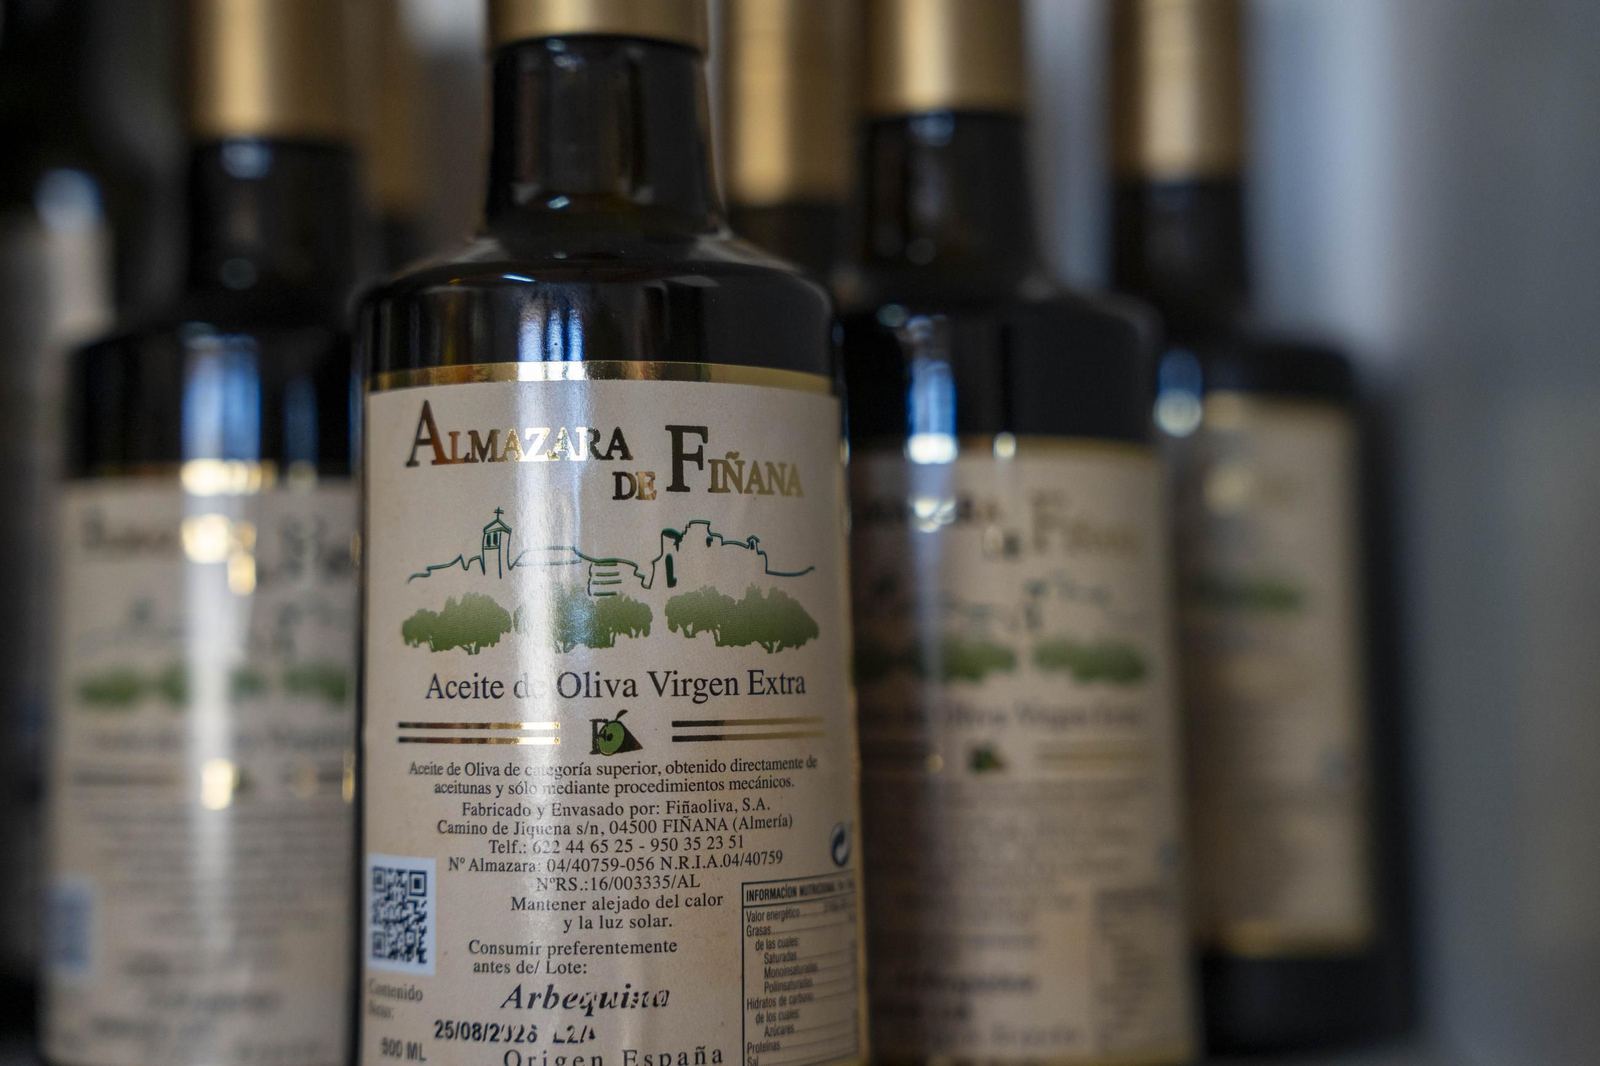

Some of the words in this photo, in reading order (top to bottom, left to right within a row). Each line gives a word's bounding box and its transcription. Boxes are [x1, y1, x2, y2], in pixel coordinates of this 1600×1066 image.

[406, 400, 633, 467] ALMAZARA
[612, 471, 657, 501] DE
[665, 425, 804, 498] FIÑANA
[426, 672, 505, 700] Aceite
[556, 671, 639, 699] Oliva
[647, 670, 739, 704] Virgen
[747, 669, 806, 697] Extra
[409, 760, 444, 776] Aceite
[447, 762, 461, 776] de
[464, 761, 501, 777] Oliva
[504, 761, 521, 776] de
[596, 760, 662, 780] superior,
[665, 758, 727, 776] obtenido
[730, 756, 804, 774] directamente
[806, 754, 818, 769] de
[434, 781, 491, 796] aceitunas
[495, 784, 504, 799] y
[508, 780, 538, 796] sólo
[543, 779, 610, 796] mediante
[614, 778, 725, 798] procedimientos
[729, 775, 795, 793] mecánicos.
[462, 802, 532, 817] Fabricado
[537, 805, 545, 820] y
[551, 802, 624, 817] Envasado
[630, 804, 661, 820] por:
[665, 799, 738, 815] Fiñaoliva,
[742, 797, 770, 812] S.A.
[437, 819, 488, 836] Camino
[492, 820, 509, 836] de
[576, 820, 605, 837] s/n,
[609, 818, 657, 835] 04500
[662, 815, 729, 834] FIÑANA
[732, 813, 793, 834] (Almería)
[489, 839, 527, 854] Telf.:
[532, 840, 561, 854] 622
[566, 839, 585, 854] 44
[590, 839, 609, 853] 65
[615, 838, 633, 853] 25
[650, 837, 678, 852] 950
[683, 837, 701, 851] 35
[706, 835, 724, 850] 23
[728, 834, 744, 849] 51
[448, 857, 466, 872] Nº
[468, 857, 541, 873] Almazara:
[546, 856, 655, 873] 04/40759-056
[511, 896, 587, 912] Mantener
[592, 894, 650, 914] alejado
[655, 894, 680, 909] del
[685, 893, 724, 908] calor
[563, 918, 573, 933] y
[579, 915, 593, 930] la
[600, 914, 624, 930] luz
[629, 914, 673, 929] solar.
[746, 910, 765, 923] Valor
[468, 939, 542, 956] Consumir
[547, 940, 678, 960] preferentemente
[755, 939, 764, 951] de
[766, 937, 776, 949] las
[473, 962, 511, 974] antes
[516, 960, 541, 975] de/
[546, 960, 587, 975] Lote:
[747, 994, 777, 1010] Hidratos
[778, 994, 787, 1006] de
[755, 1011, 765, 1024] de
[766, 1010, 777, 1023] los
[407, 1041, 427, 1063] ML
[747, 1040, 780, 1055] Proteínas
